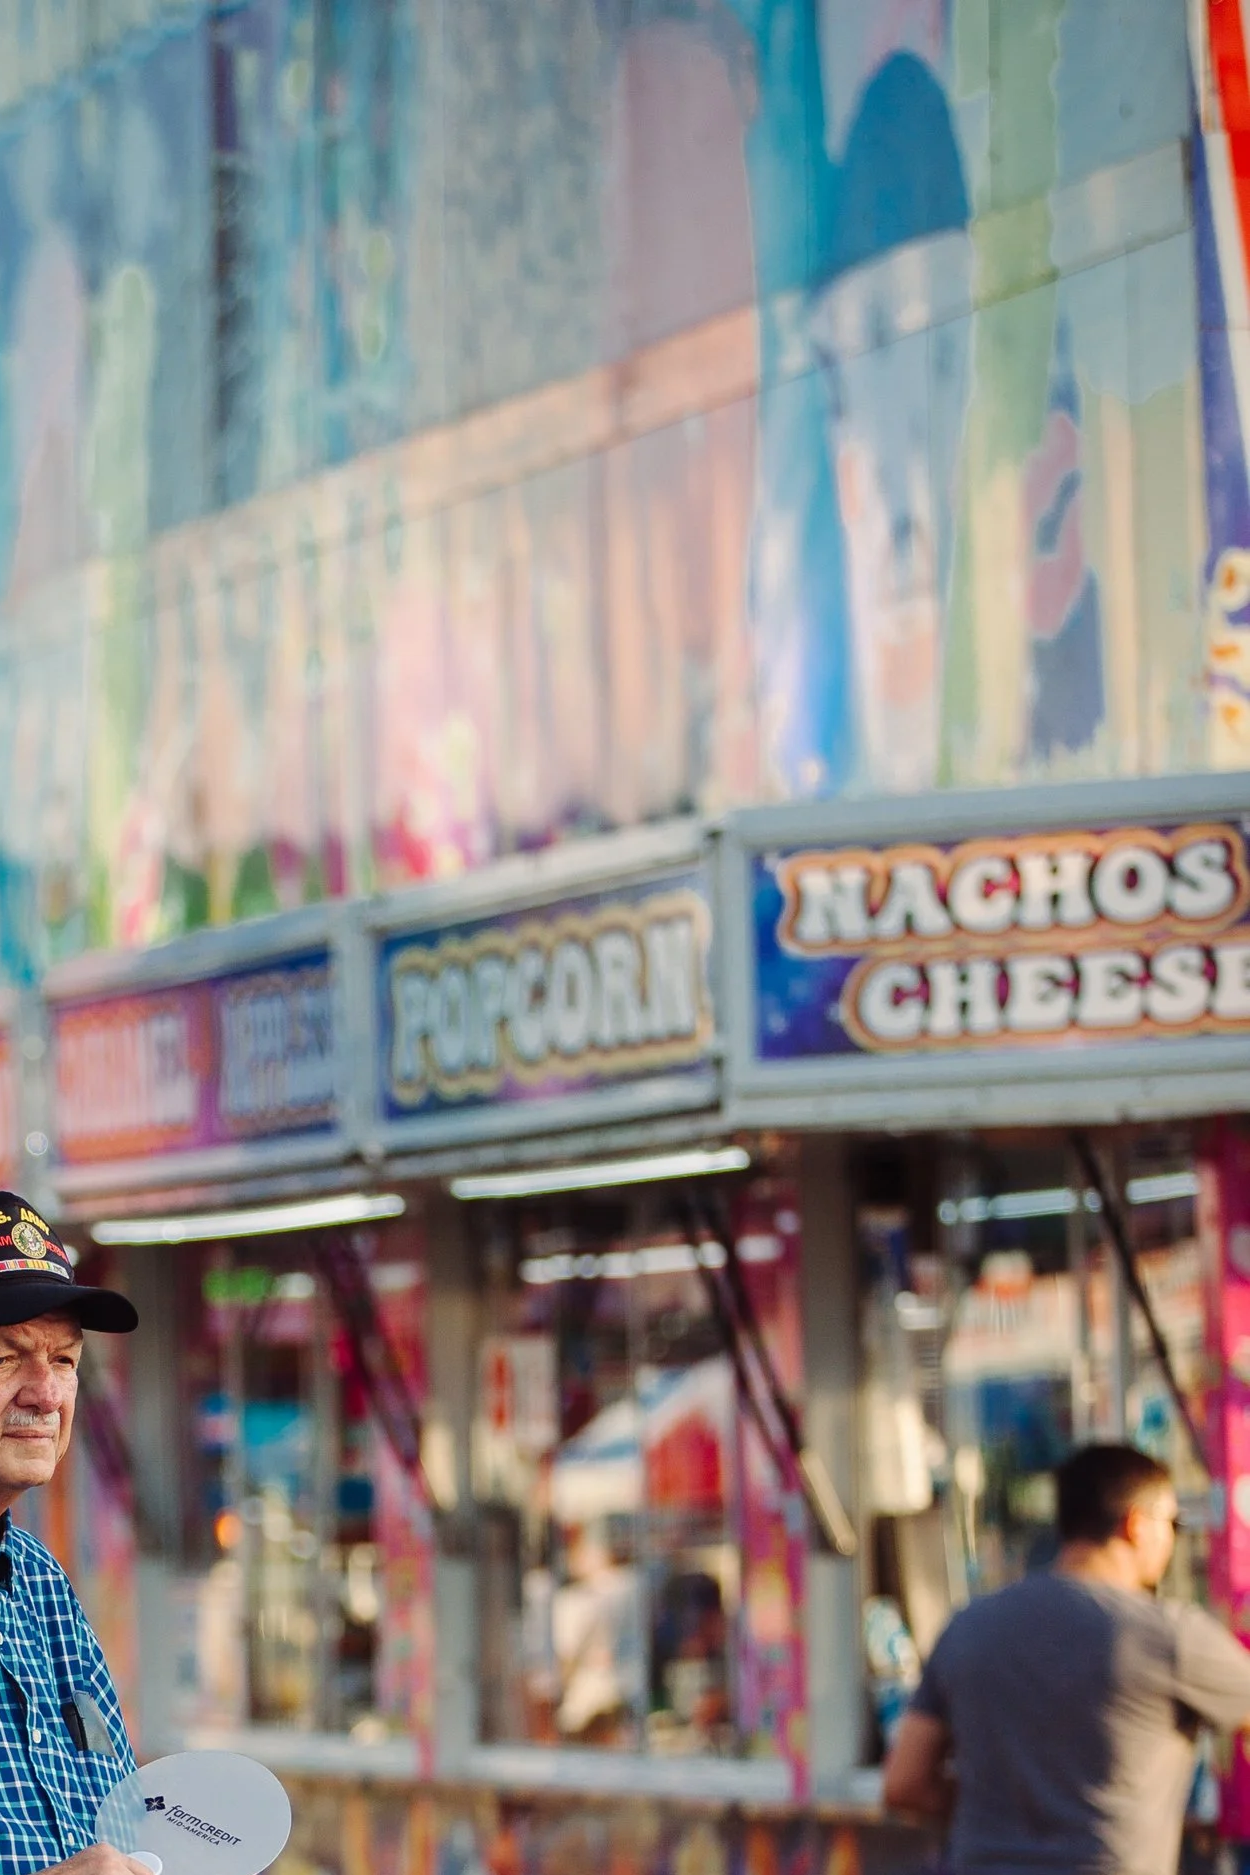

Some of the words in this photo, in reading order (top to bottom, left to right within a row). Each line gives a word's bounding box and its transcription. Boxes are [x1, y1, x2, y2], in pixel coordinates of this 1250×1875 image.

[791, 836, 1240, 943] NACHOS
[393, 915, 694, 1083] POPCORN
[855, 936, 1250, 1040] CHEESE
[20, 1207, 50, 1236] ARMY
[44, 1239, 69, 1264] VETER
[166, 1816, 221, 1846] MID-AMERICA
